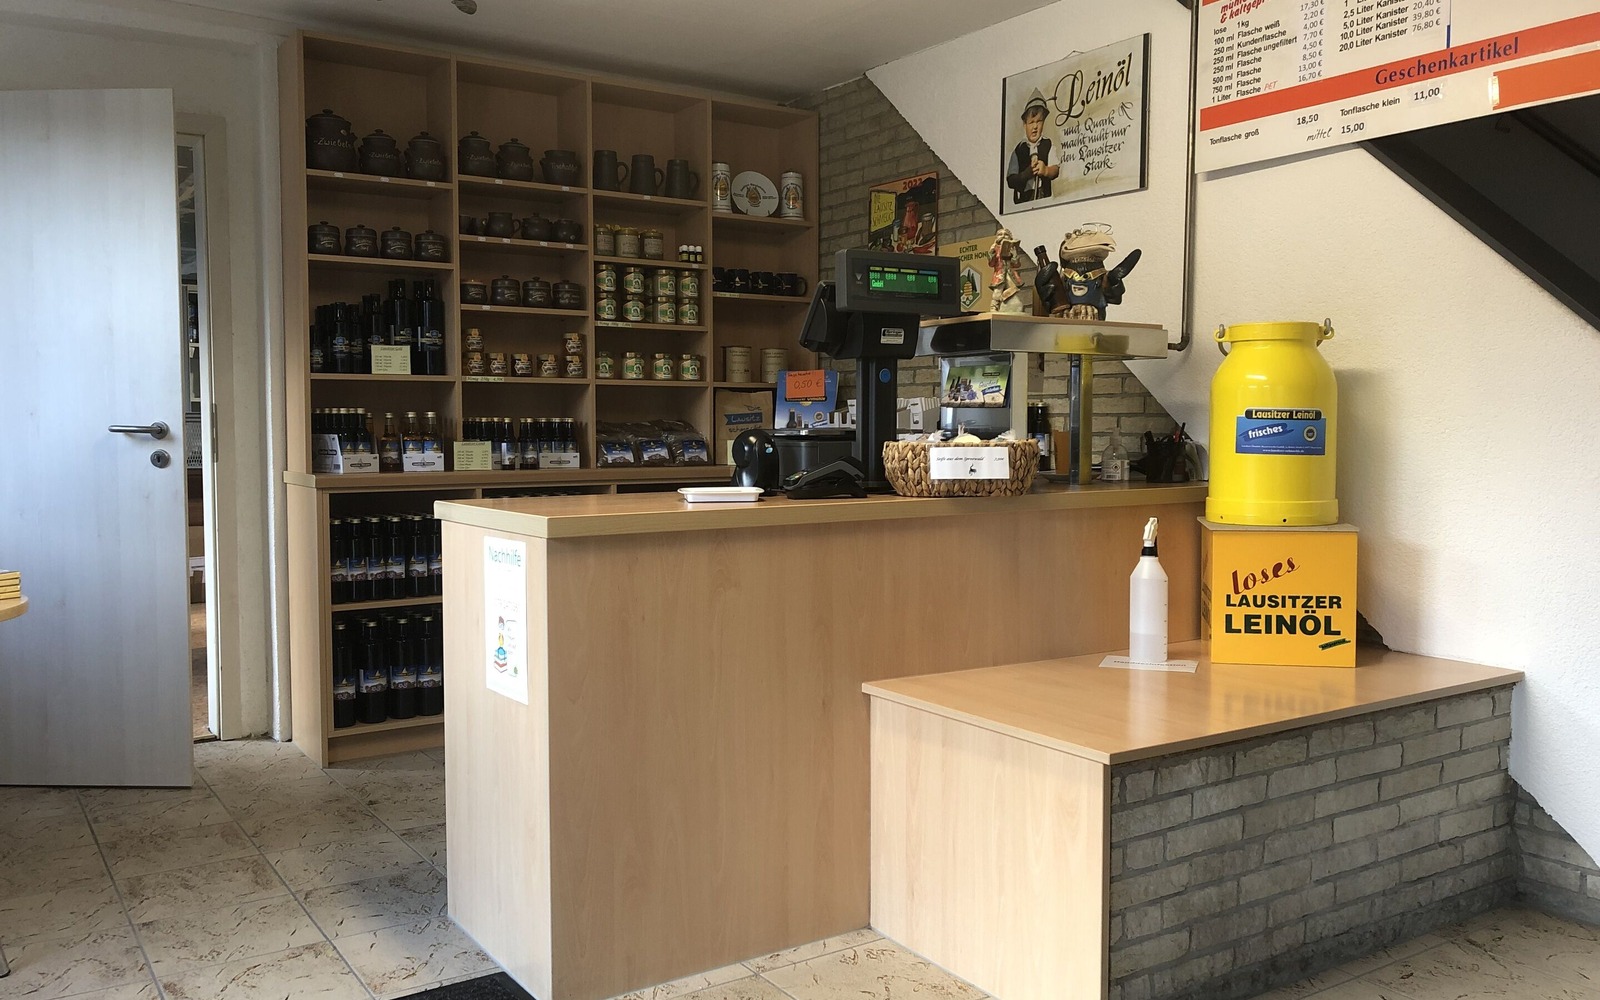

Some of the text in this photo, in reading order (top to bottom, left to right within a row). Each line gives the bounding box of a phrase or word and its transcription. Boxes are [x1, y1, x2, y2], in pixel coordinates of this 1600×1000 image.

[1214, 26, 1227, 35] lose
[1300, 1, 1318, 11] 17,30
[1343, 20, 1354, 29] 5,0
[1356, 15, 1374, 26] Liter
[1376, 6, 1409, 20] Kanister
[1344, 9, 1355, 18] 2,5
[1356, 4, 1374, 14] Liter
[1214, 37, 1225, 45] 100
[1226, 34, 1234, 43] ml
[1238, 26, 1262, 39] Flasche
[1265, 20, 1280, 31] weiß
[1304, 11, 1318, 20] 2,20
[1339, 43, 1354, 52] 20,0
[1356, 37, 1373, 47] Liter
[1375, 28, 1408, 42] Kanister
[1412, 21, 1433, 32] 76,80
[1340, 31, 1354, 40] 10,0
[1356, 26, 1373, 37] Liter
[1376, 16, 1408, 31] Kanister
[1413, 10, 1434, 21] 39,80
[1213, 56, 1224, 65] 250
[1237, 46, 1262, 58] Flasche
[1264, 36, 1297, 51] ungefiltert
[1303, 31, 1318, 41] 7,70
[1214, 47, 1225, 56] 250
[1226, 44, 1234, 53] ml
[1237, 29, 1286, 49] Kundenflasche
[1303, 21, 1318, 30] 4,00
[1213, 66, 1224, 74] 250
[1237, 56, 1262, 68] Flasche
[1303, 41, 1317, 50] 4,50
[1213, 76, 1224, 84] 500
[1225, 73, 1233, 82] ml
[1237, 67, 1261, 78] Flasche
[1302, 52, 1316, 61] 8,50
[1376, 37, 1519, 85] Geschenkartikel
[1054, 52, 1132, 126] Leinöl
[1212, 86, 1223, 94] 750
[1237, 76, 1261, 88] Flasche
[1299, 62, 1316, 72] 13,00
[1264, 80, 1278, 91] PET
[1299, 72, 1316, 82] 16,70
[1217, 93, 1231, 102] Liter
[1236, 86, 1261, 98] Flasche
[1340, 87, 1440, 117] Tonflasche klein 11,00
[1063, 109, 1115, 136] und Quark
[1210, 114, 1319, 146] Tonflasche groß 18,50
[1341, 122, 1365, 134] 15,00
[1061, 125, 1131, 150] macht nicht nur
[1060, 141, 1125, 165] den Lausitzer
[902, 178, 923, 190] 2022
[959, 245, 978, 253] ECHTER
[872, 280, 884, 288] GmbH
[794, 378, 822, 389] 0,50 €
[1252, 410, 1316, 419] Lausitzer Leinöl
[1248, 426, 1283, 438] frisches
[488, 545, 521, 567] Nachhilfe
[1232, 557, 1300, 595] loses
[1226, 594, 1342, 609] LAUSITZER
[1225, 610, 1341, 635] LEINÖL
